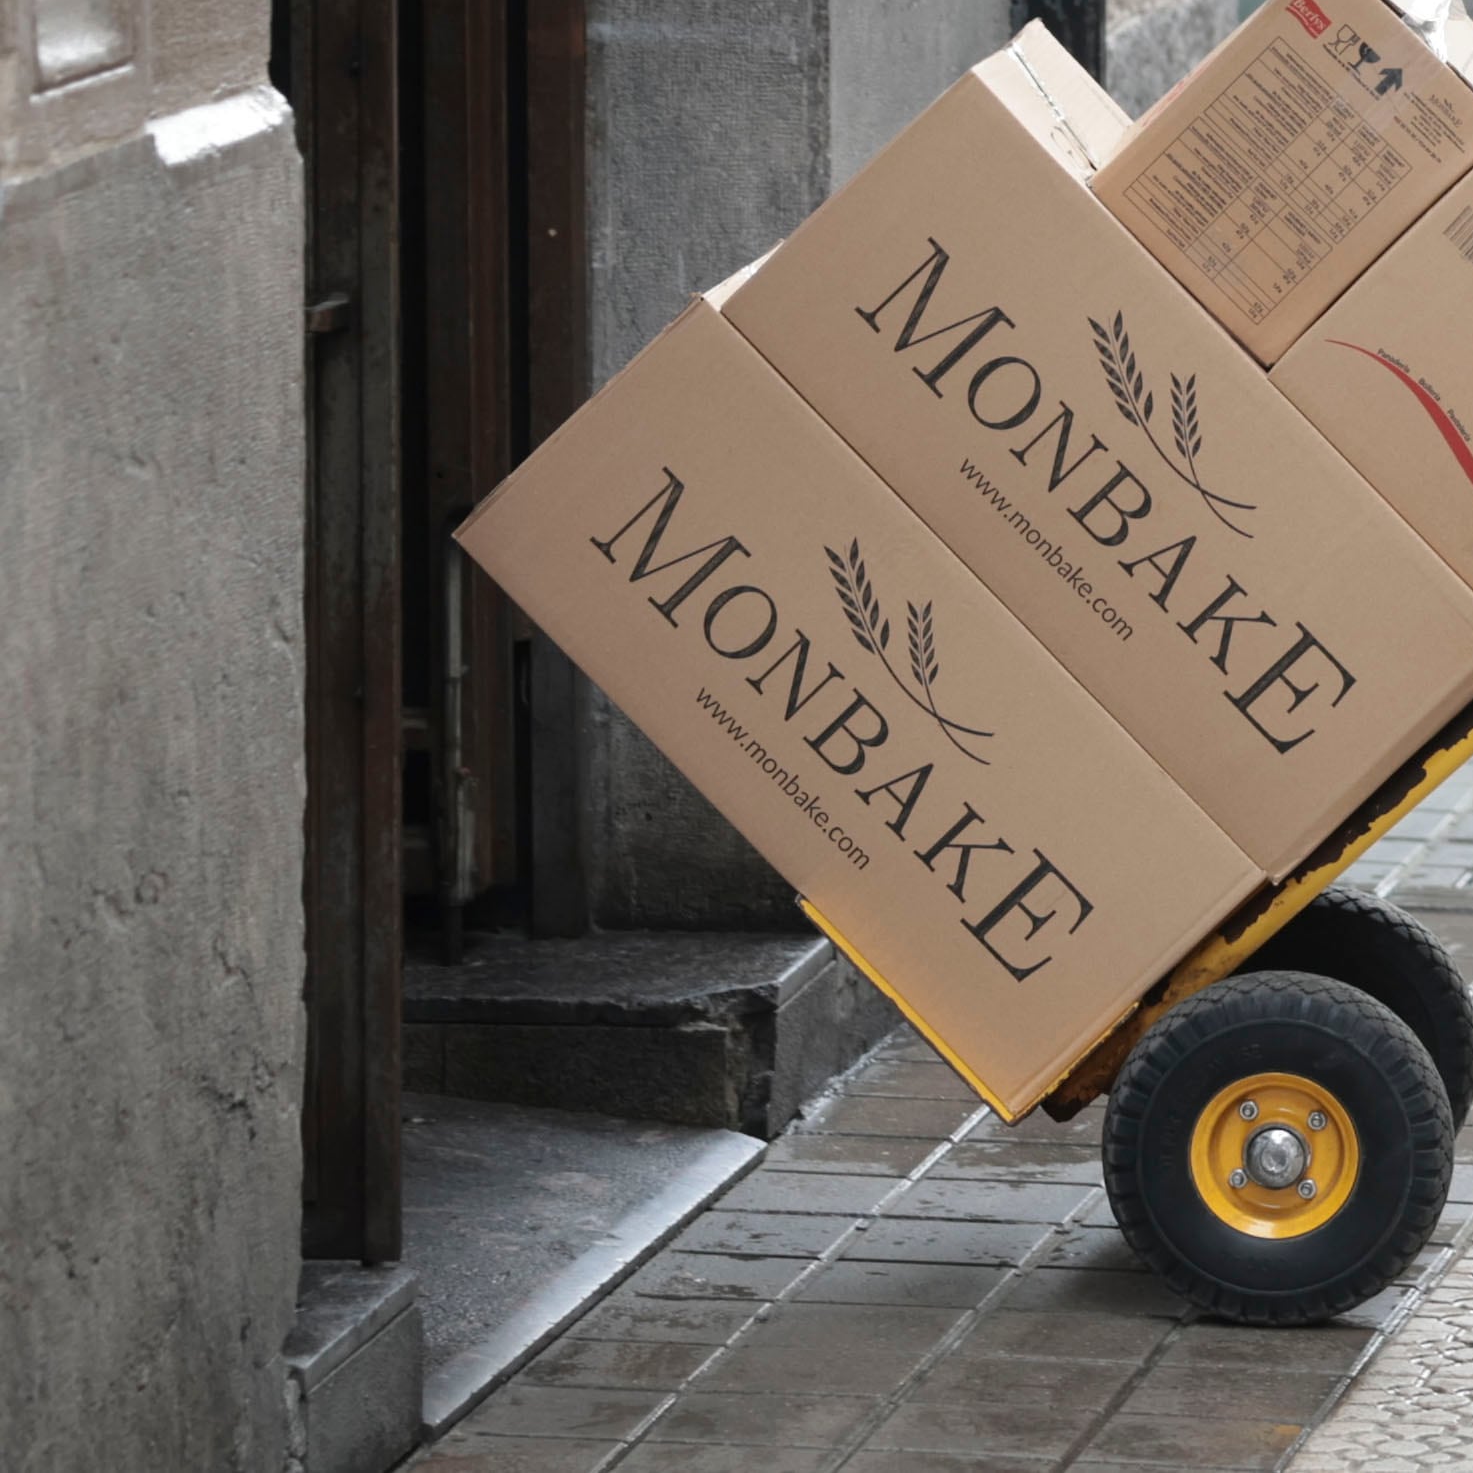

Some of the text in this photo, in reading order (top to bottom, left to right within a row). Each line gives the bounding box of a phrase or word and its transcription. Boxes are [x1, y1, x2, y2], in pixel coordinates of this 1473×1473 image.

[855, 237, 1357, 755] MONBAKE
[959, 456, 1135, 643] www.monbake.com
[589, 467, 1095, 983] MONBAKE
[695, 686, 872, 873] www.monbake.com
